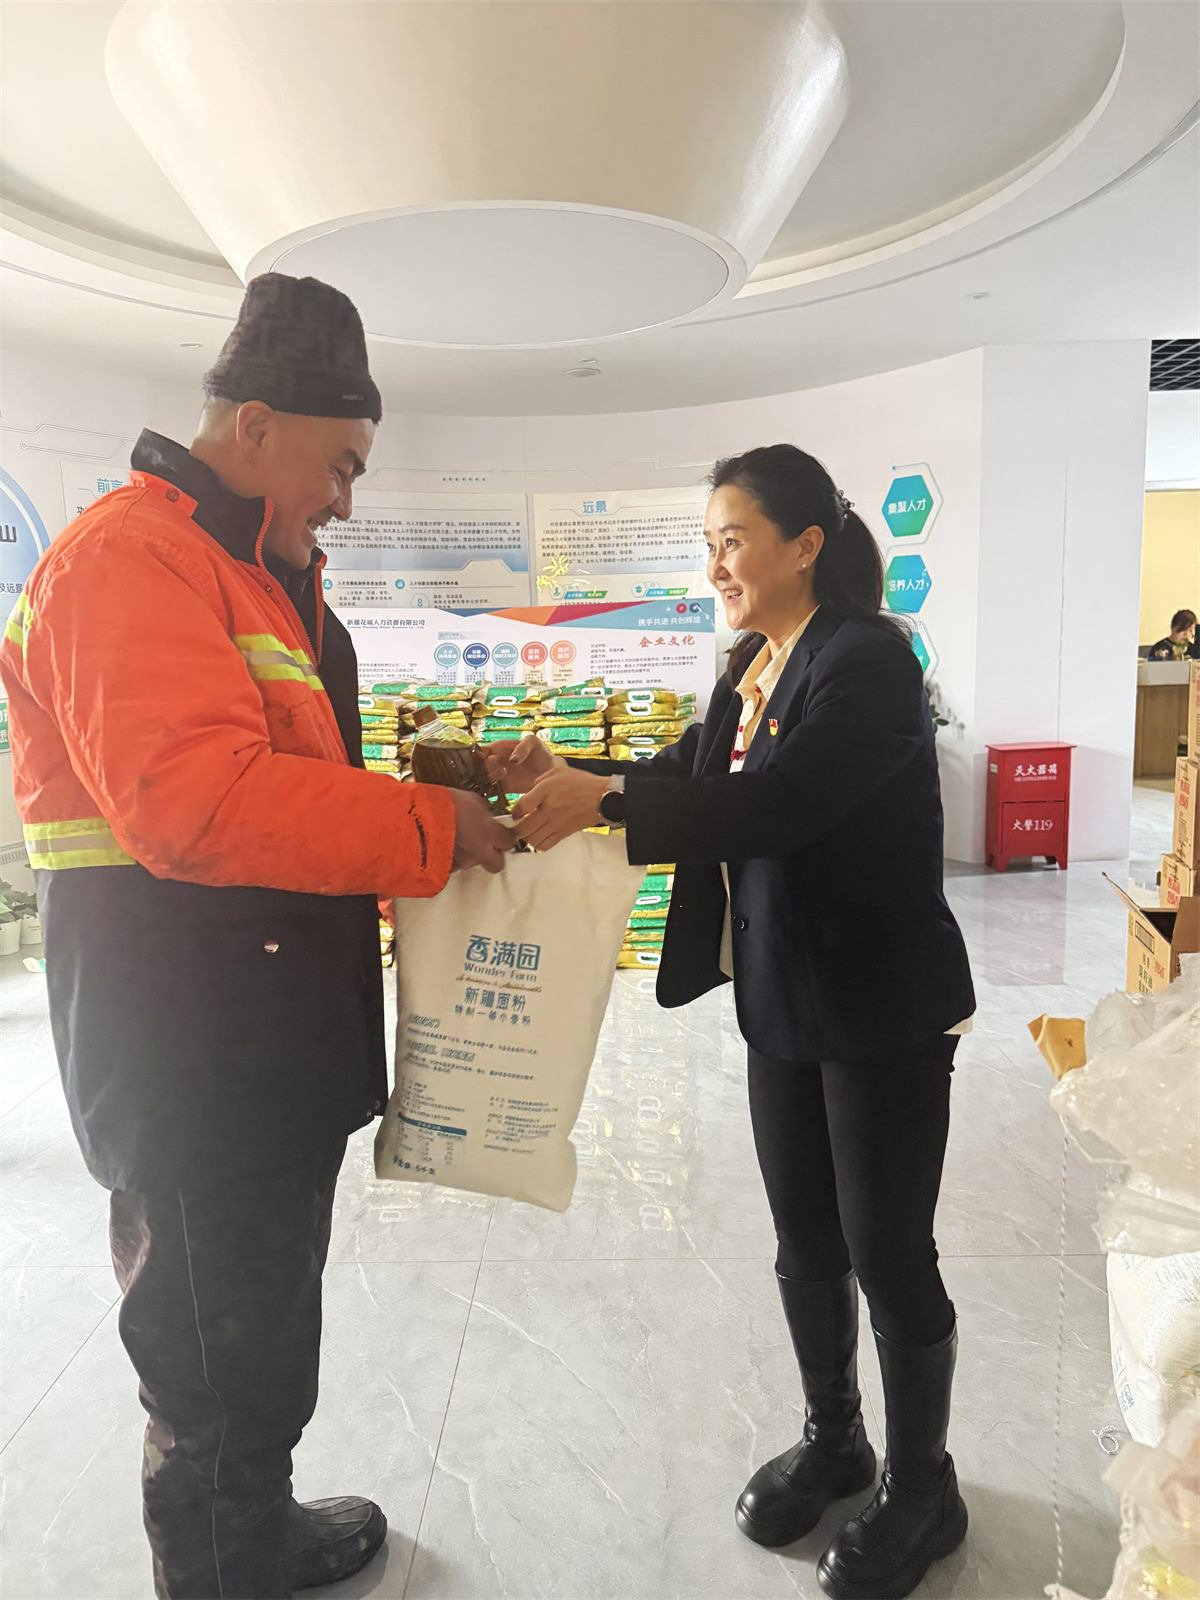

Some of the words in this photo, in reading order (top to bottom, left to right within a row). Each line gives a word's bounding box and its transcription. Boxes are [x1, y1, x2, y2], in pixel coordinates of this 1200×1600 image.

[582, 500, 607, 513] 远景
[639, 634, 696, 648] 企业文化
[466, 934, 541, 970] 香满园
[464, 961, 506, 978] Wonder
[510, 969, 538, 983] Farm
[464, 986, 527, 1013] 新疆面粉
